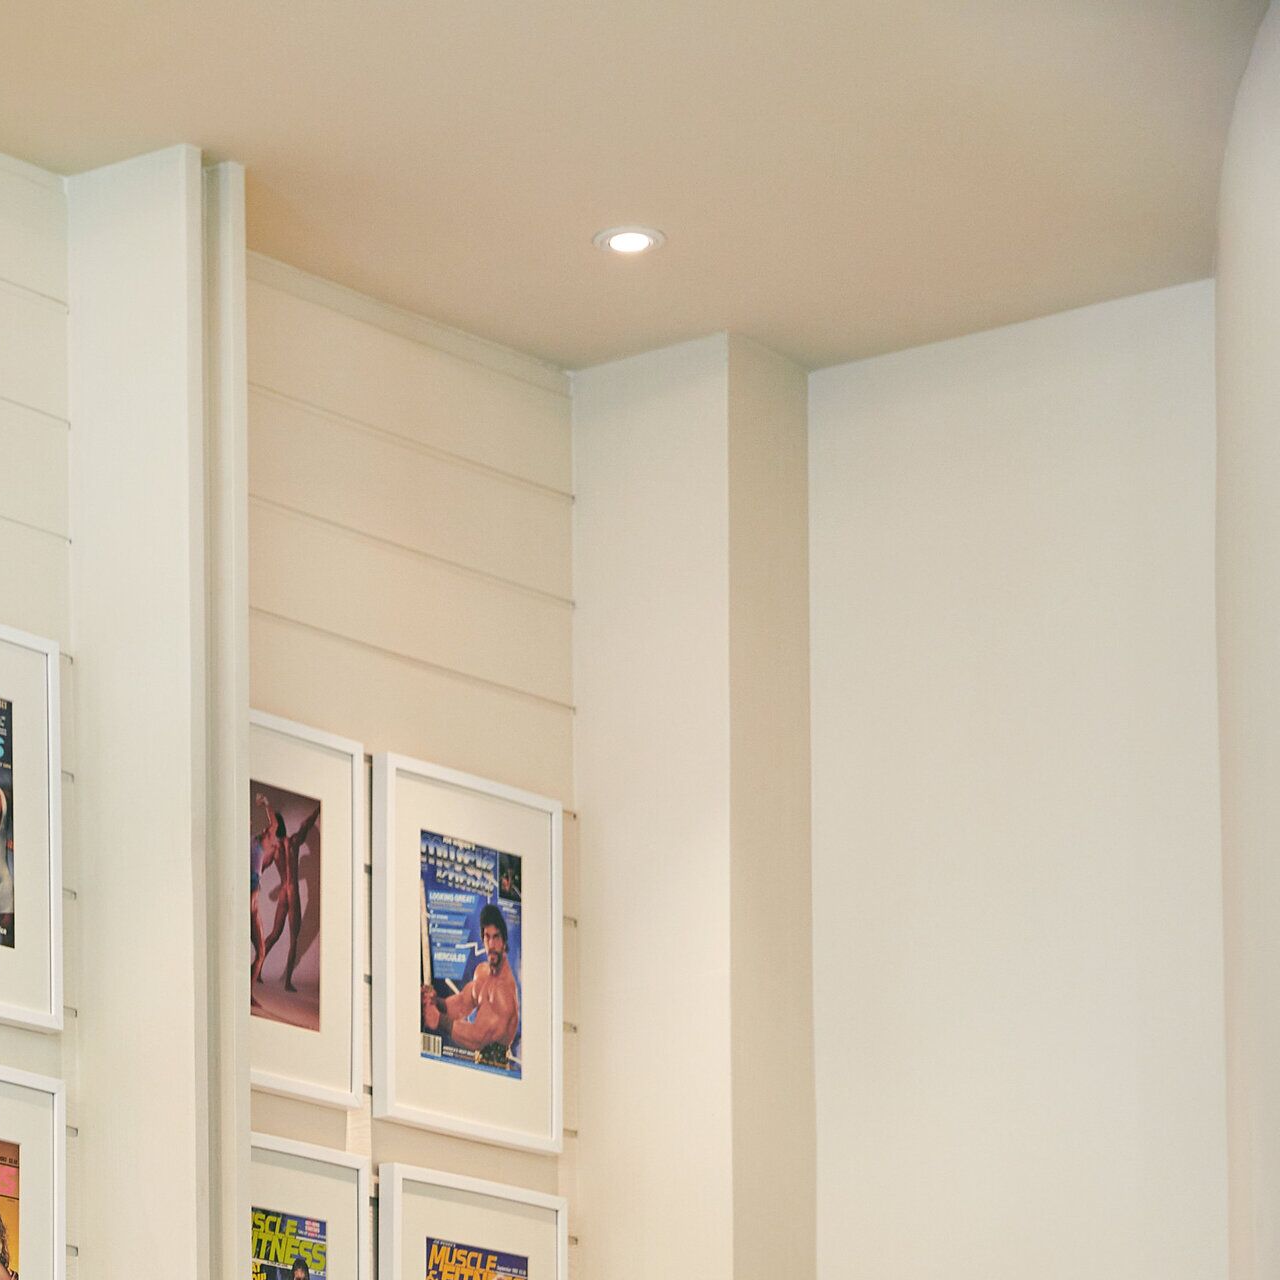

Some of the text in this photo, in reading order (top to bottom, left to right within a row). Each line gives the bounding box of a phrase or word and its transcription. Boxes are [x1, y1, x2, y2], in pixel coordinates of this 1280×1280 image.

[252, 1212, 297, 1237] SCLE
[252, 1230, 326, 1271] ITNESS
[429, 1244, 497, 1271] MUSCLE
